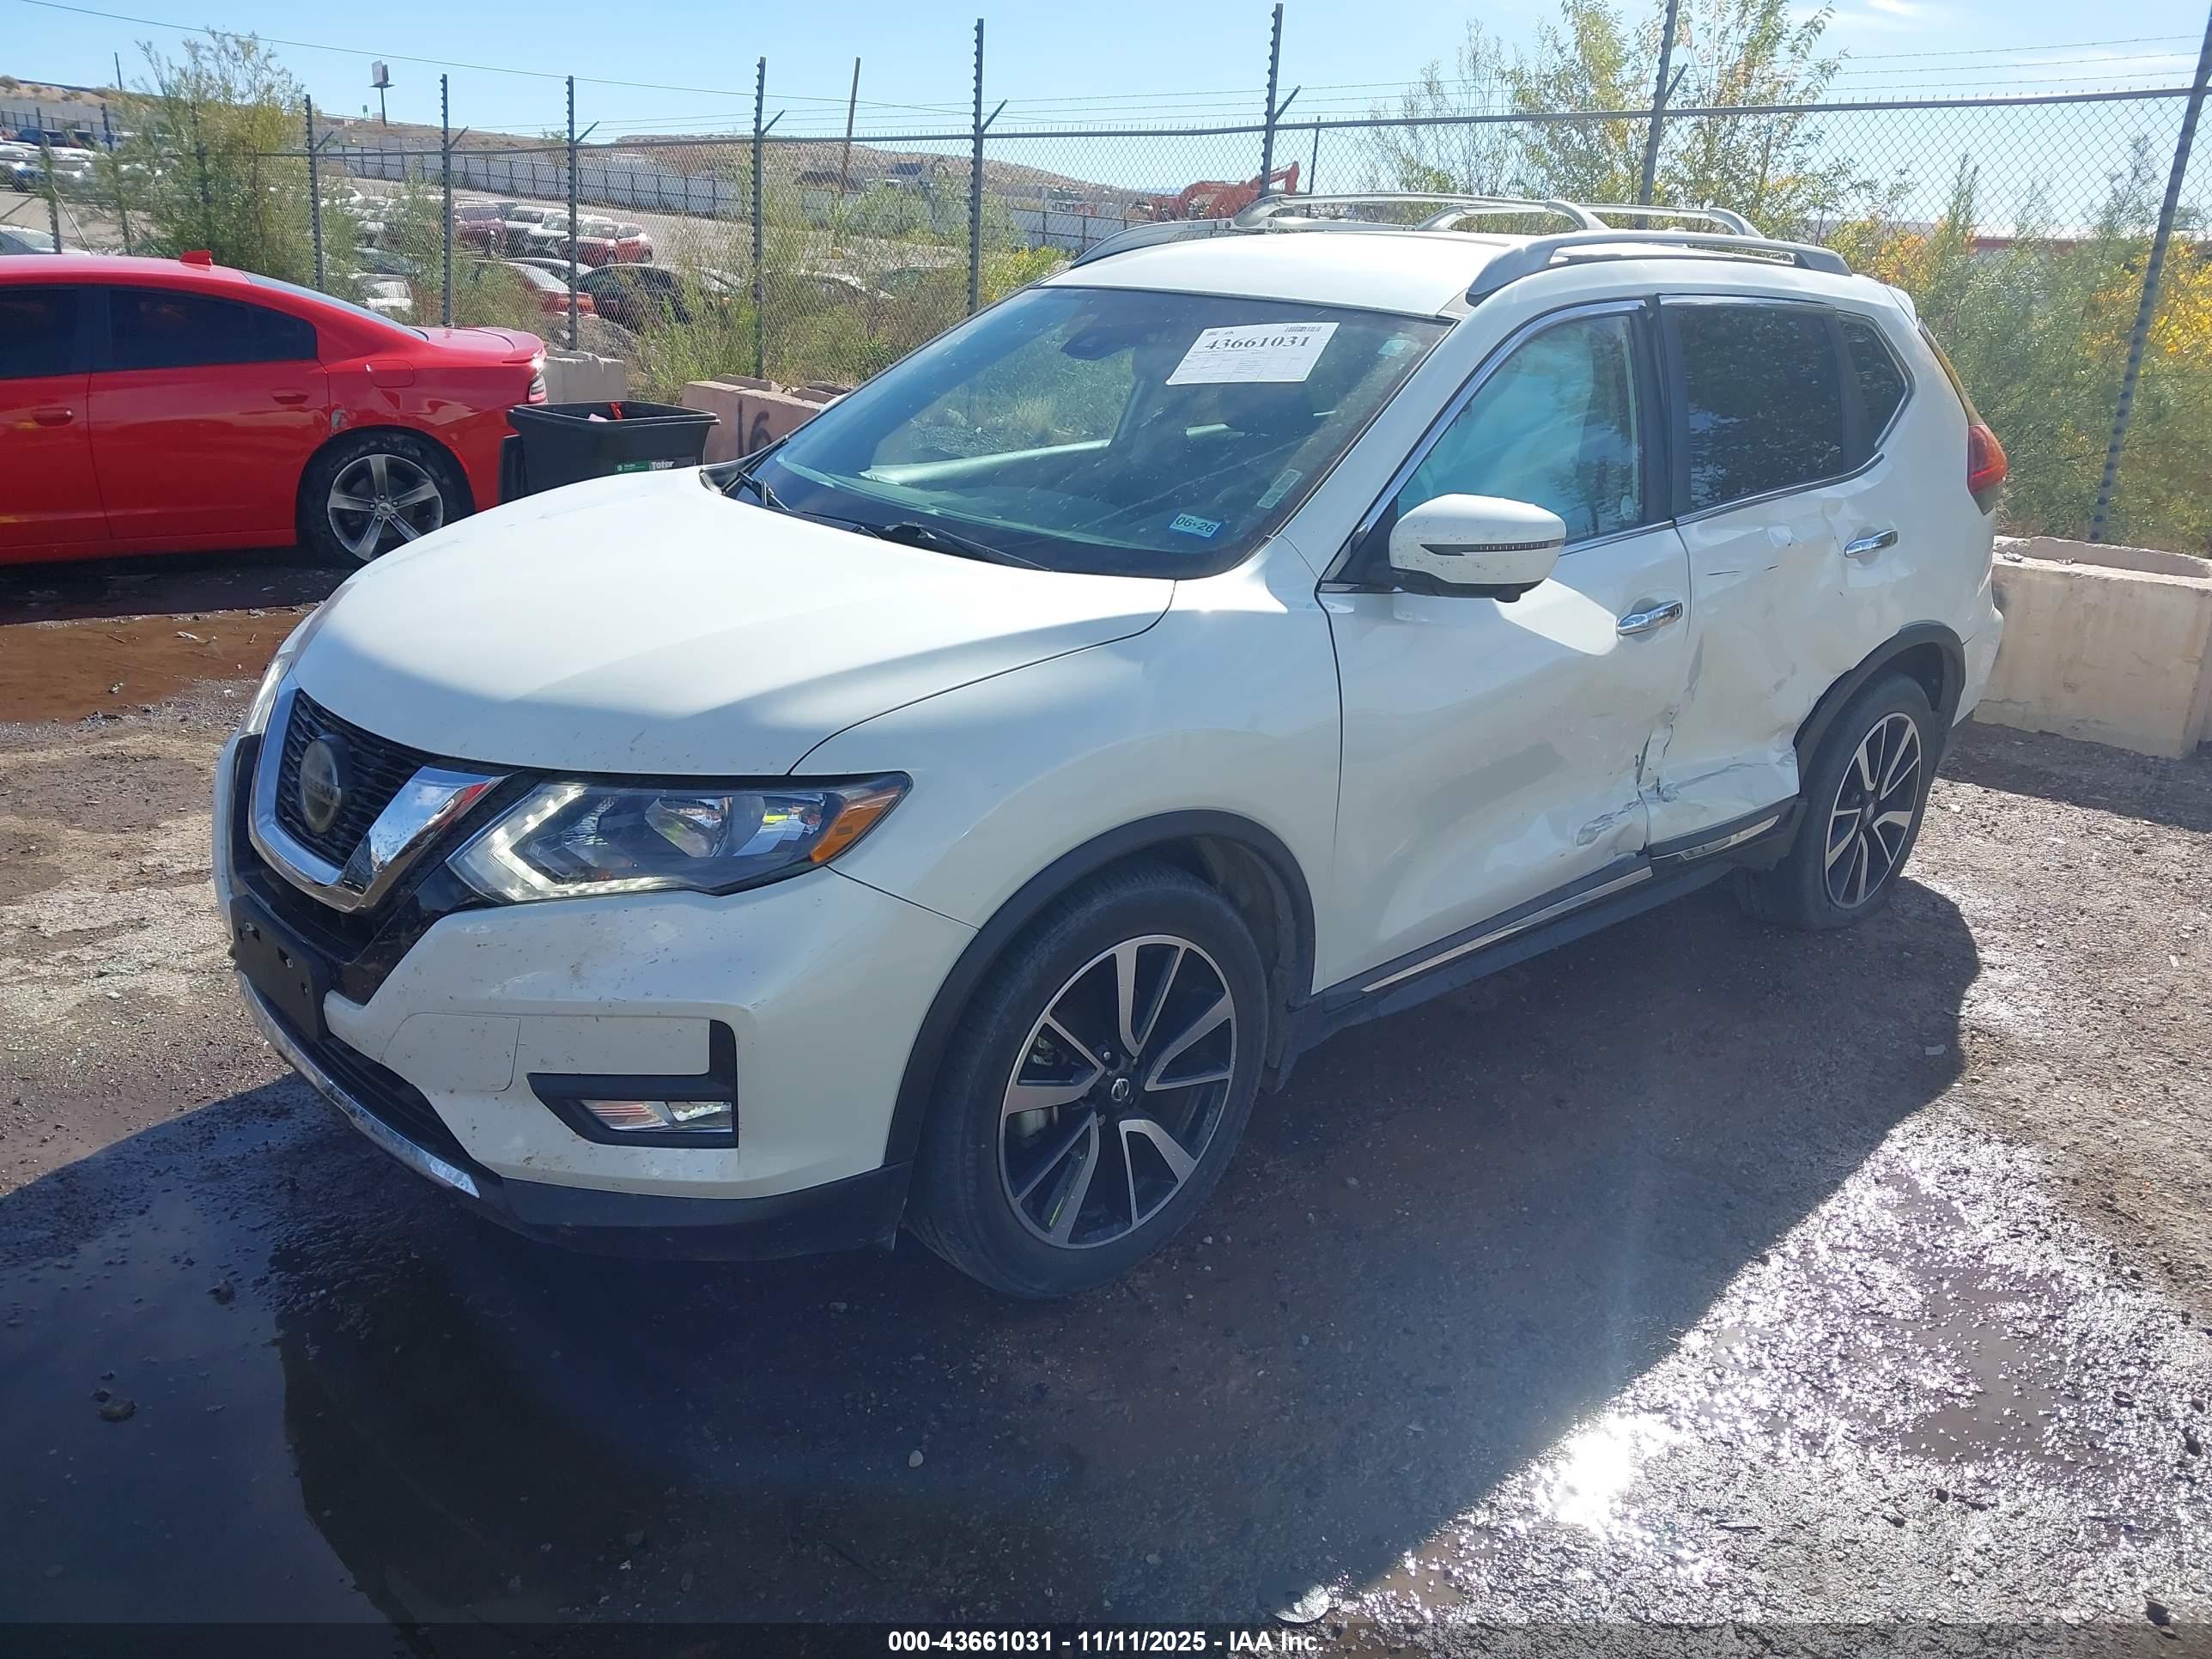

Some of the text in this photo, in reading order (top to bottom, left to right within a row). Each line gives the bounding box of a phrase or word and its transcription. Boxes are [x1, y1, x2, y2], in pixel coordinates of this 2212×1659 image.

[1204, 335, 1310, 349] 43661031
[651, 459, 675, 471] Toter
[1176, 517, 1216, 532] 06 26
